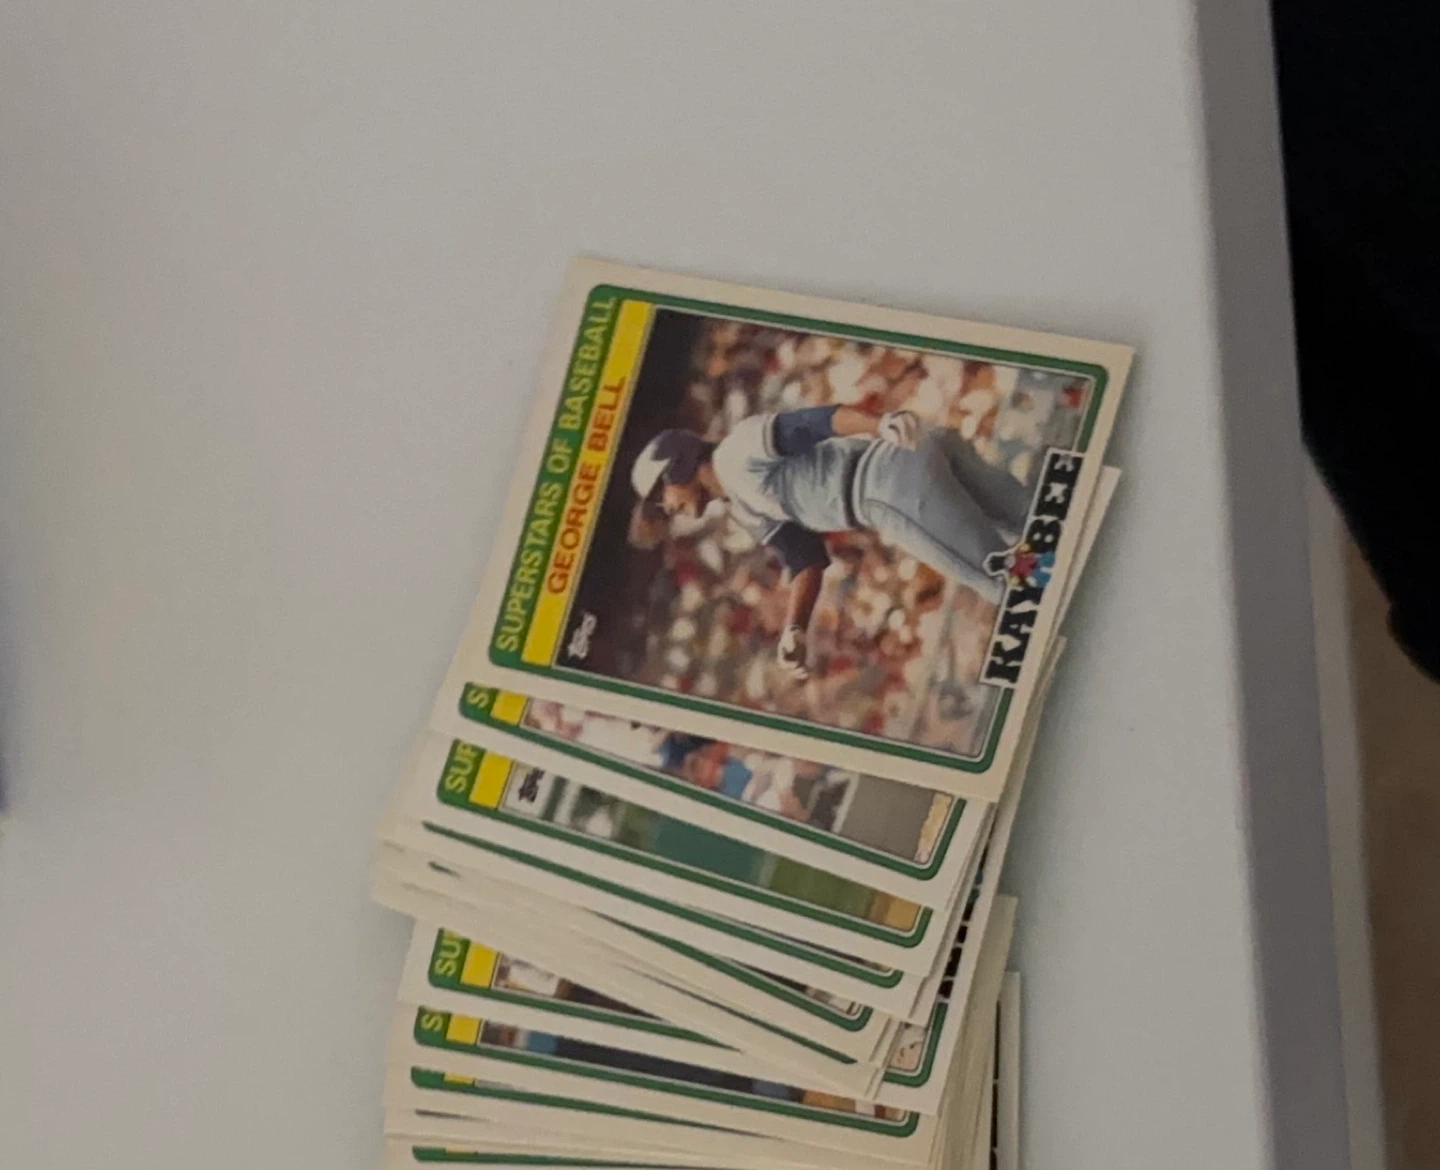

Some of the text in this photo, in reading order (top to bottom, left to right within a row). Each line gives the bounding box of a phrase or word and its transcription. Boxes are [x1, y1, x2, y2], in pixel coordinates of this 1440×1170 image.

[496, 295, 617, 652] SUPERSTARS OF BASEBALL
[546, 374, 627, 595] GEORGE BELL
[1025, 453, 1084, 555] BEE
